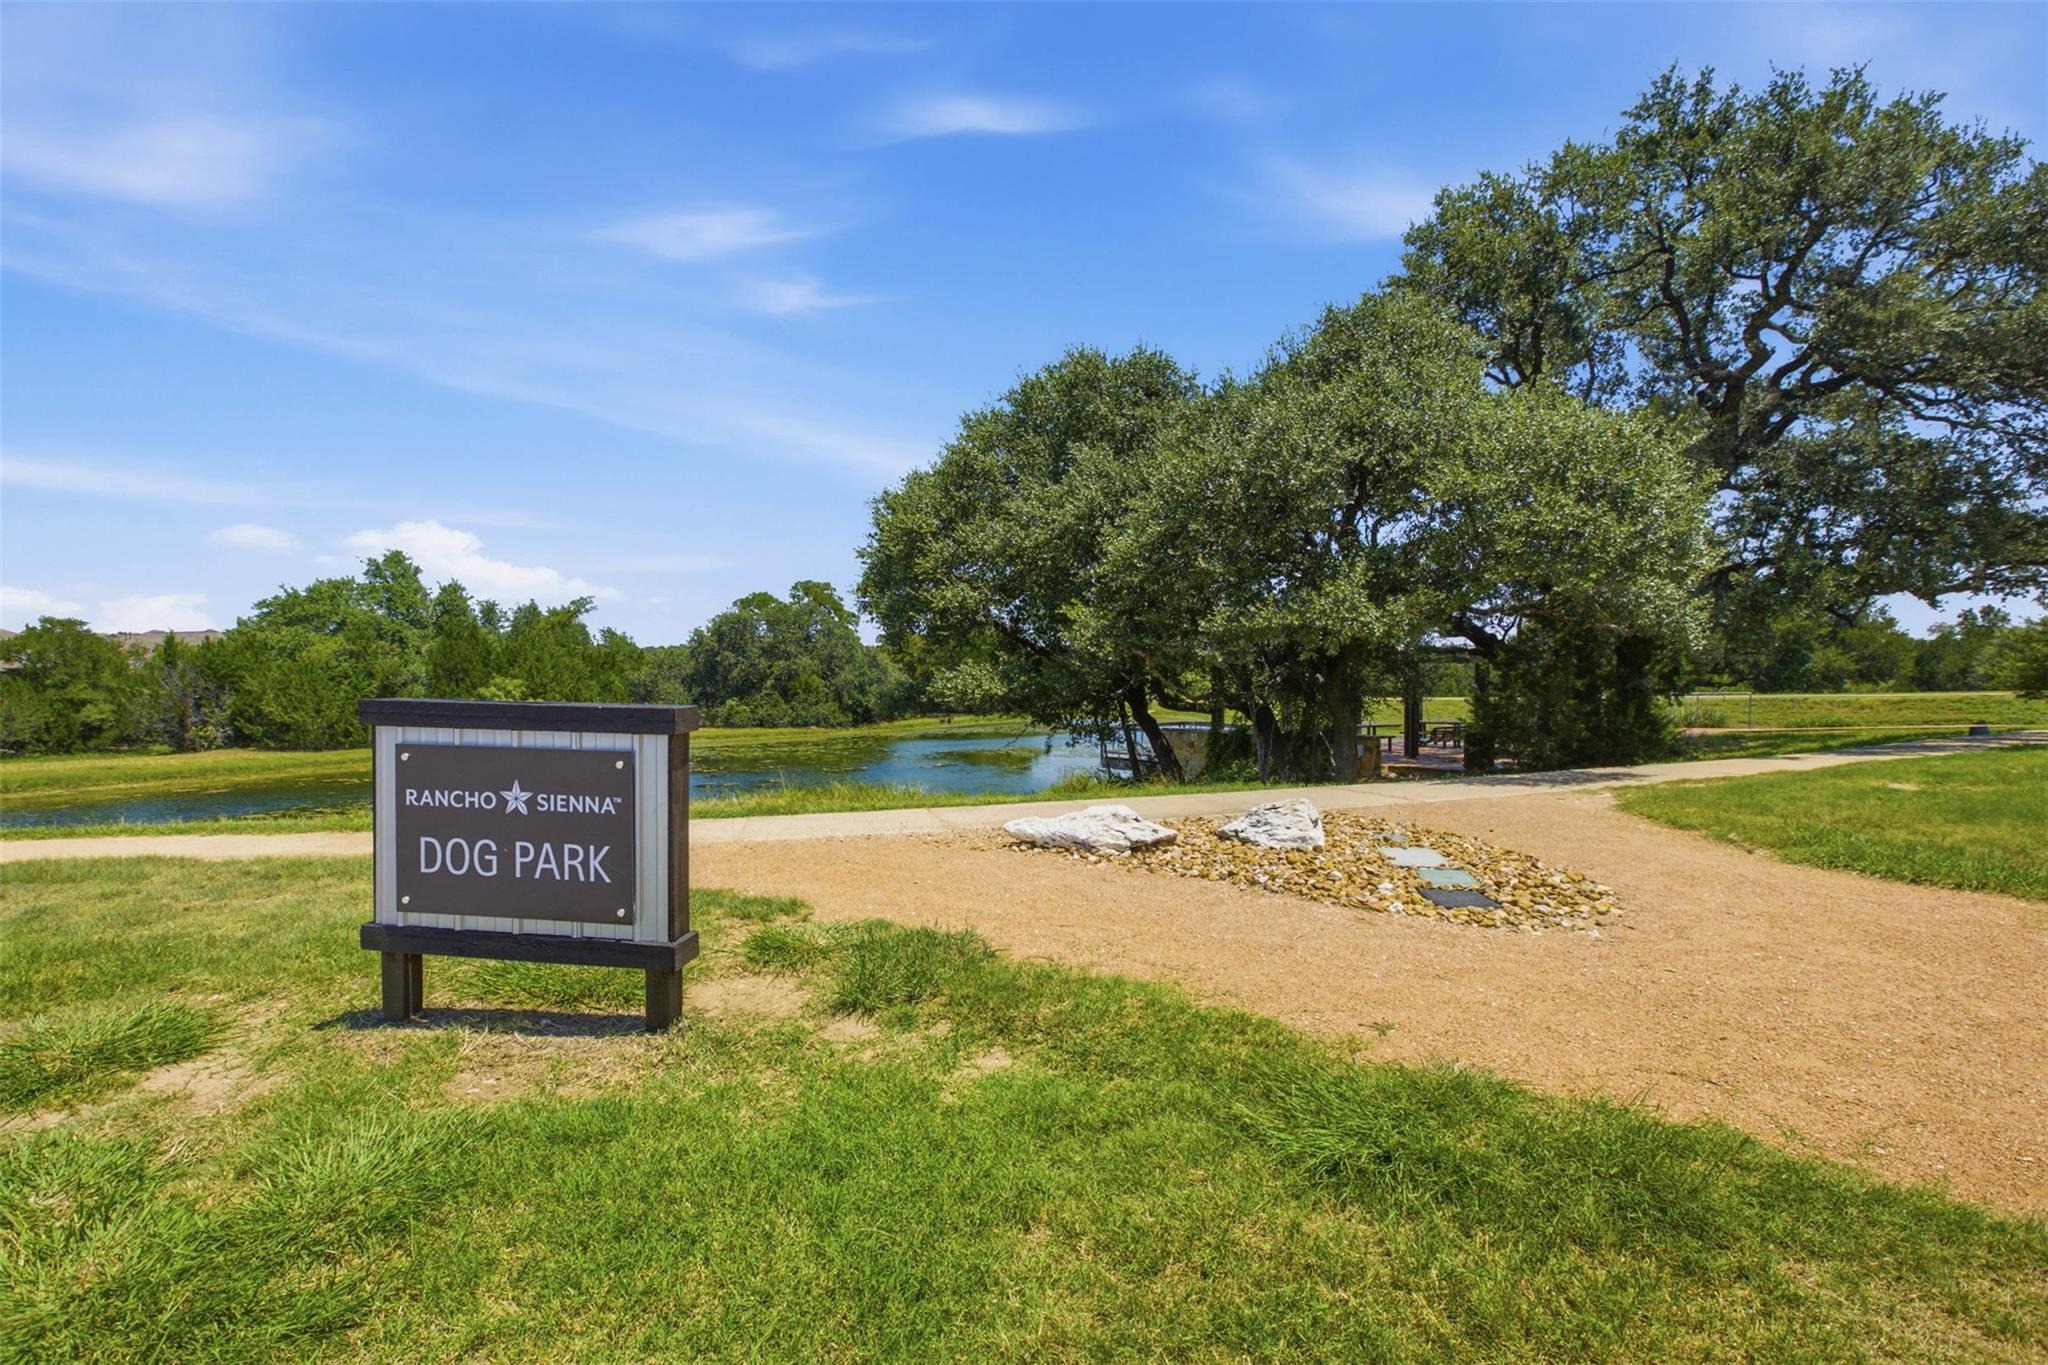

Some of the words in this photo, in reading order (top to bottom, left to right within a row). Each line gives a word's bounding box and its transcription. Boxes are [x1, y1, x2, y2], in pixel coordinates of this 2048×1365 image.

[405, 788, 497, 809] RANCHO
[419, 836, 498, 877] DOG
[514, 840, 612, 884] PARK
